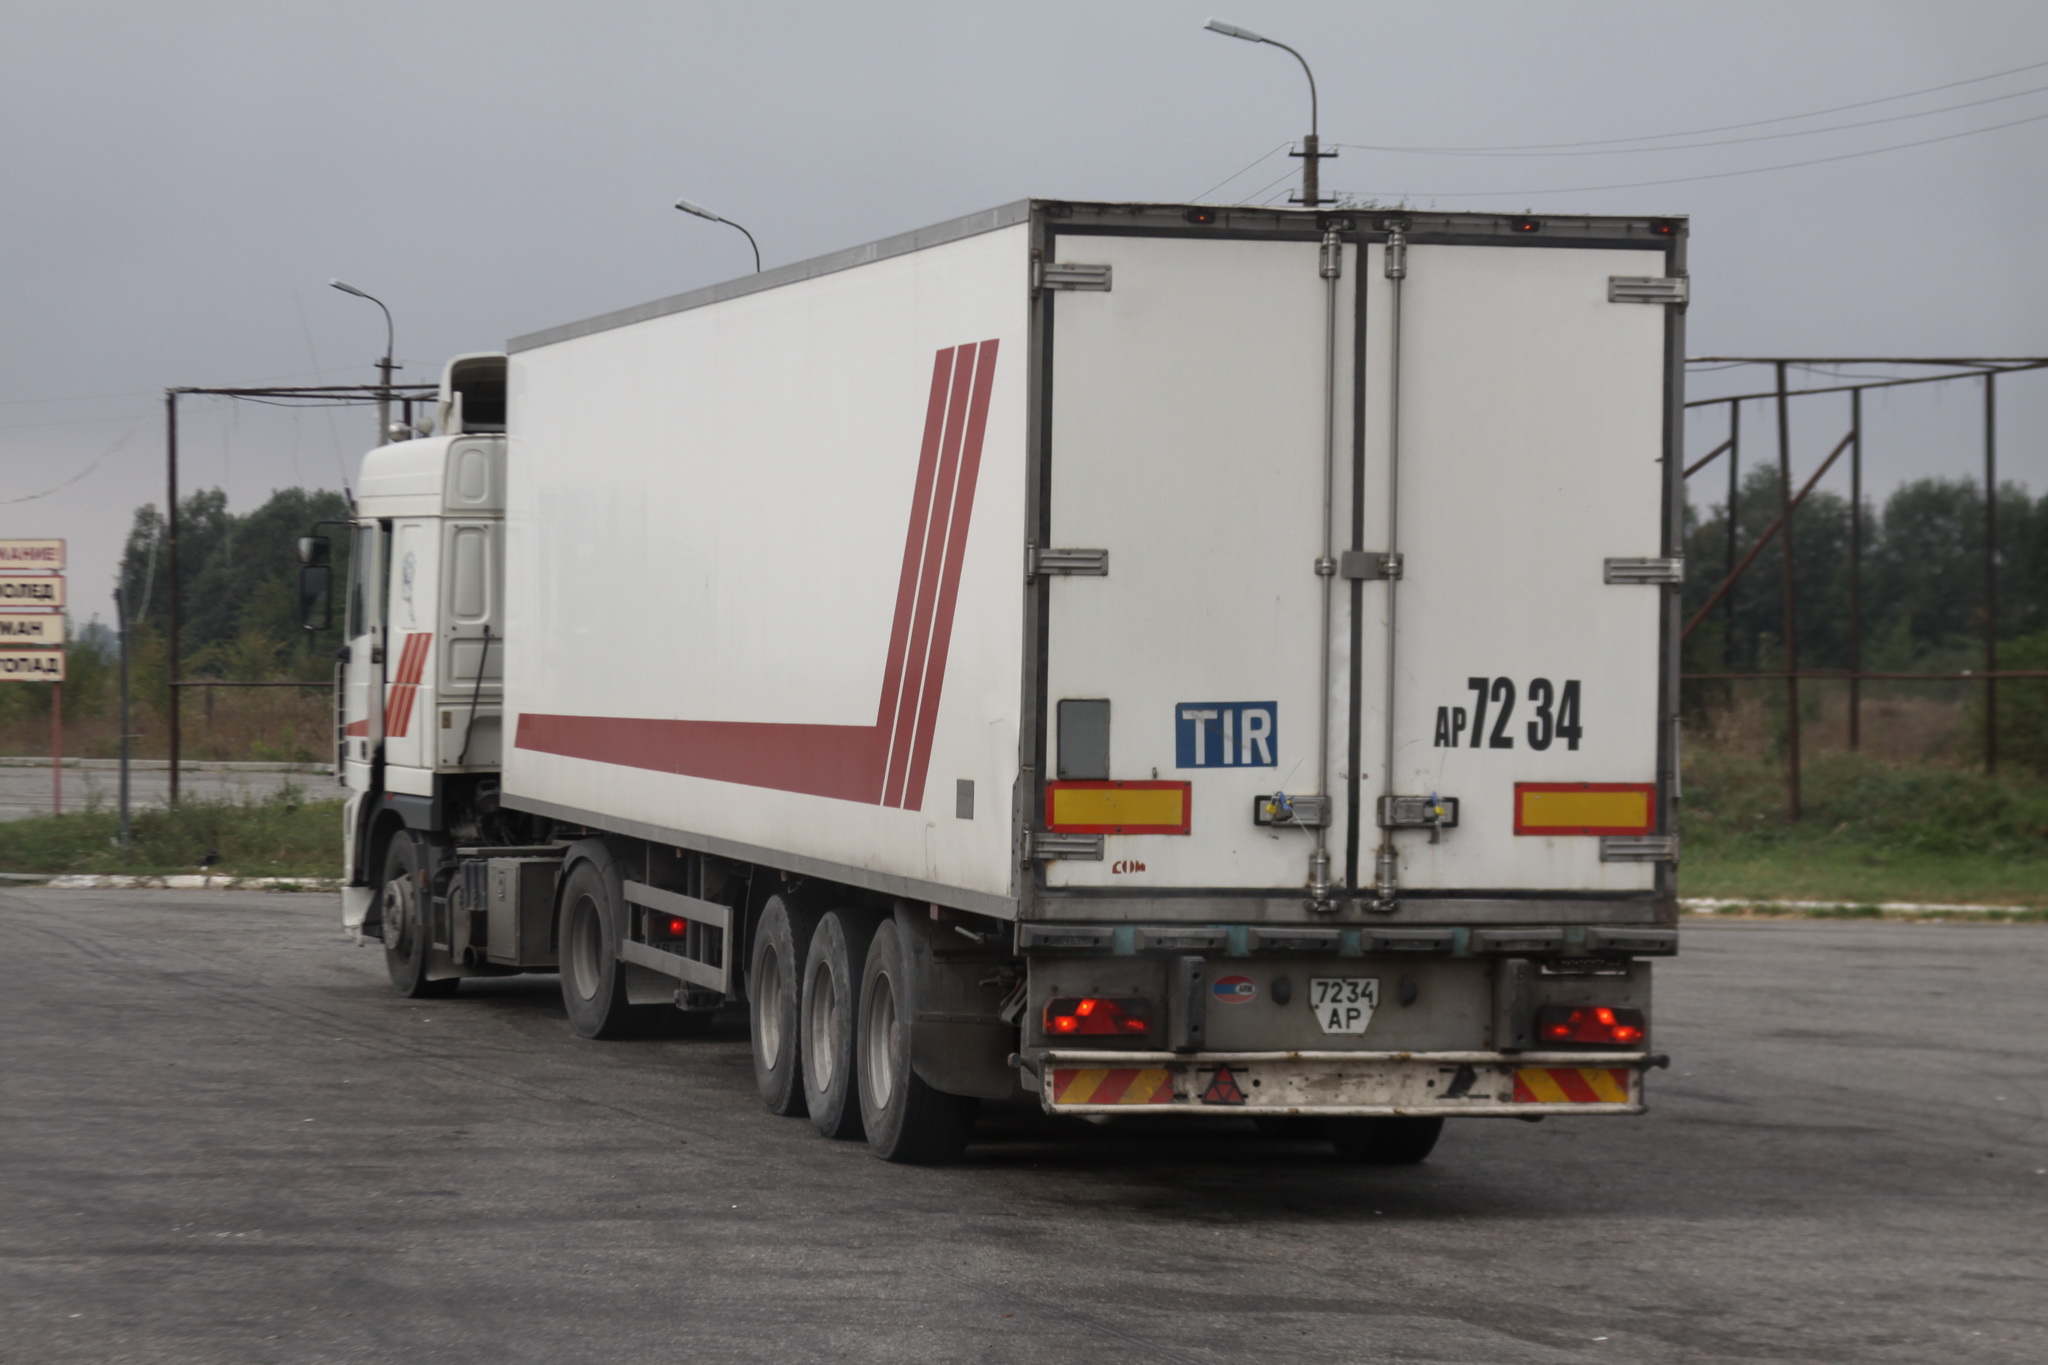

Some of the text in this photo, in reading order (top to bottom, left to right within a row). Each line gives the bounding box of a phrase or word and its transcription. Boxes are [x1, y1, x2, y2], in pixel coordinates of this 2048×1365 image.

[0, 583, 55, 602] ОЛЕД
[1182, 708, 1272, 765] TIR
[1316, 981, 1373, 1003] 7234
[1328, 1007, 1361, 1029] AP
